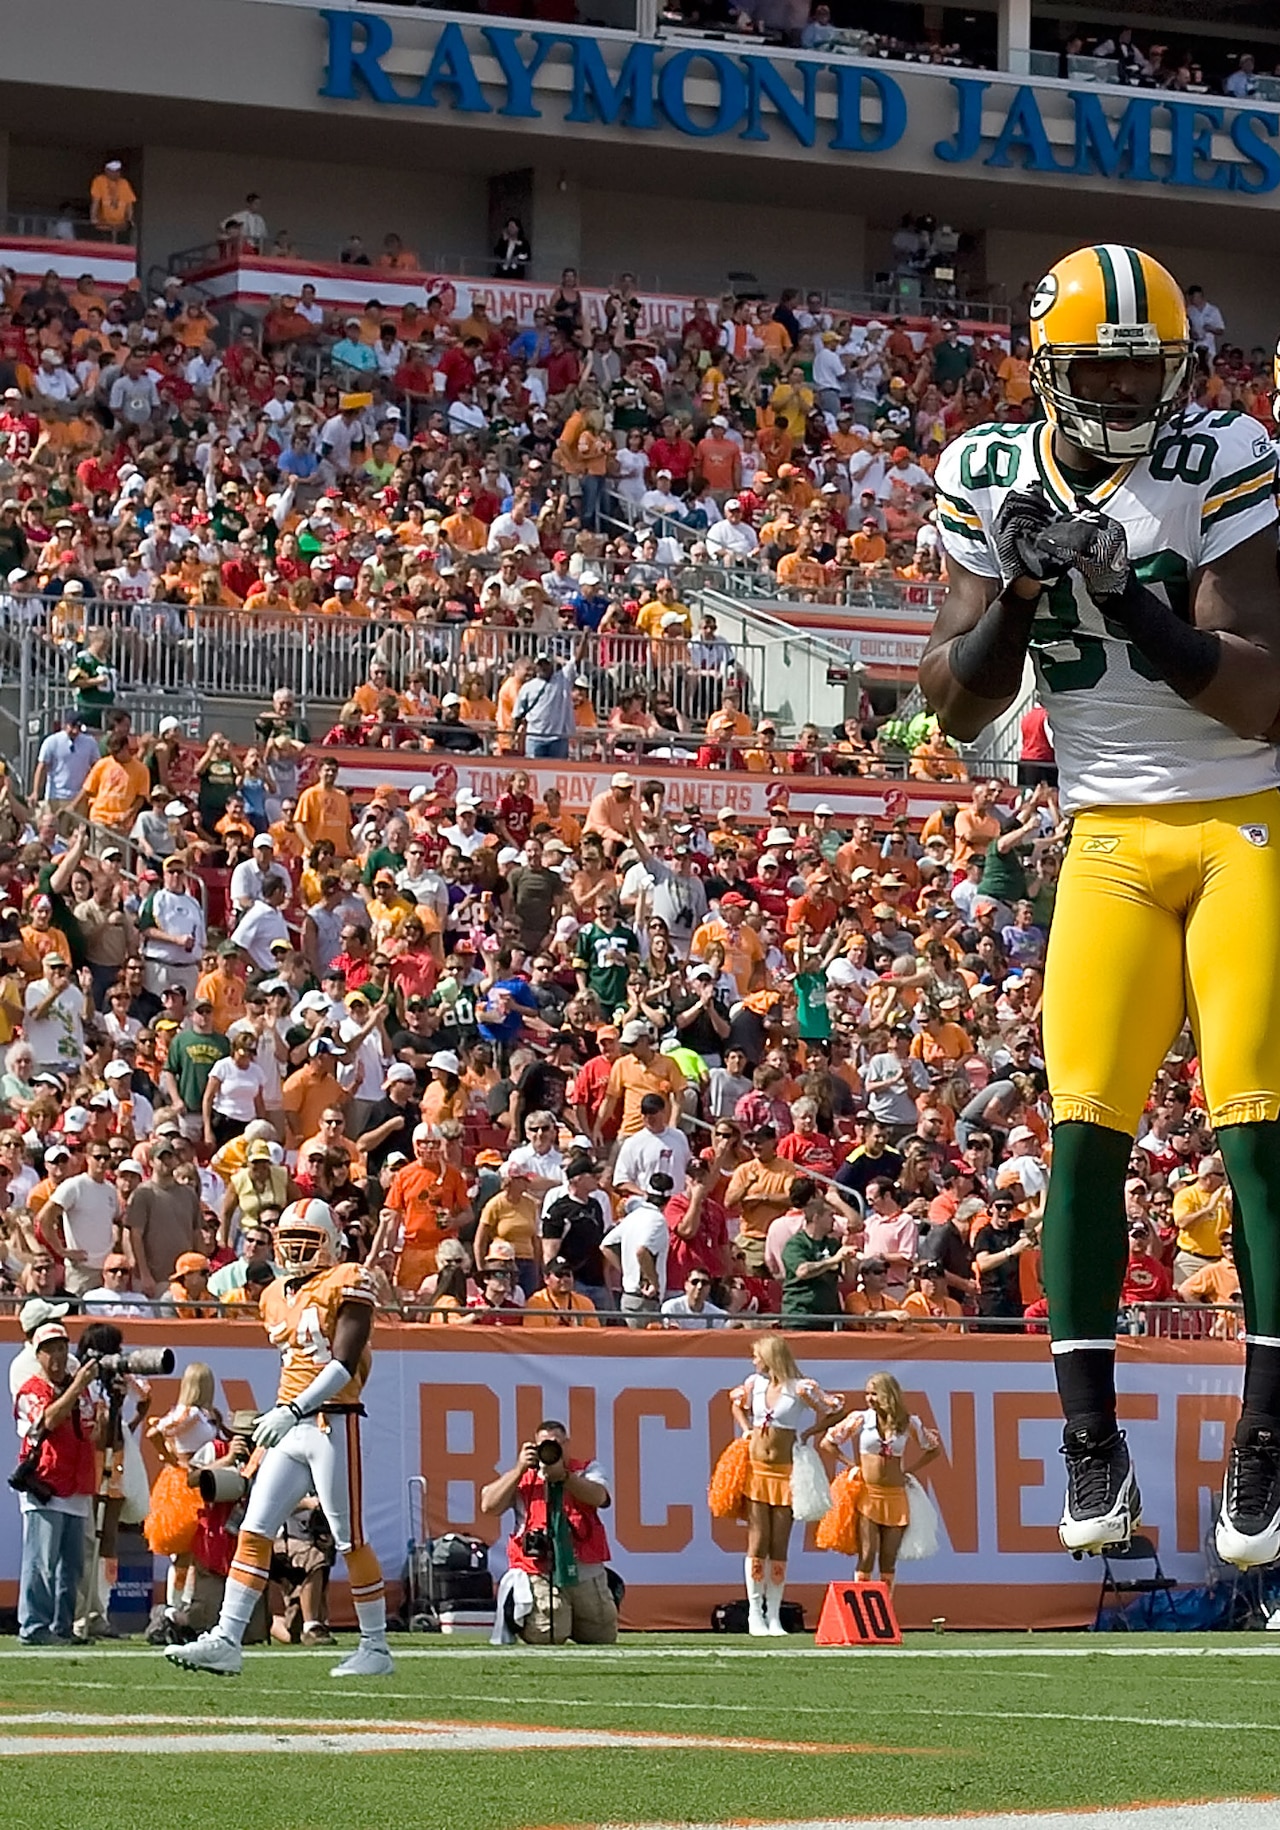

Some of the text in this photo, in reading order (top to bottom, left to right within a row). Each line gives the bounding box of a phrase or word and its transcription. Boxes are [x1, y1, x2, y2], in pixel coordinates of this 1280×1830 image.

[319, 9, 907, 152] RAYMOND
[468, 770, 540, 801] TAMA
[556, 775, 597, 802] BAY
[843, 1589, 896, 1639] 10
